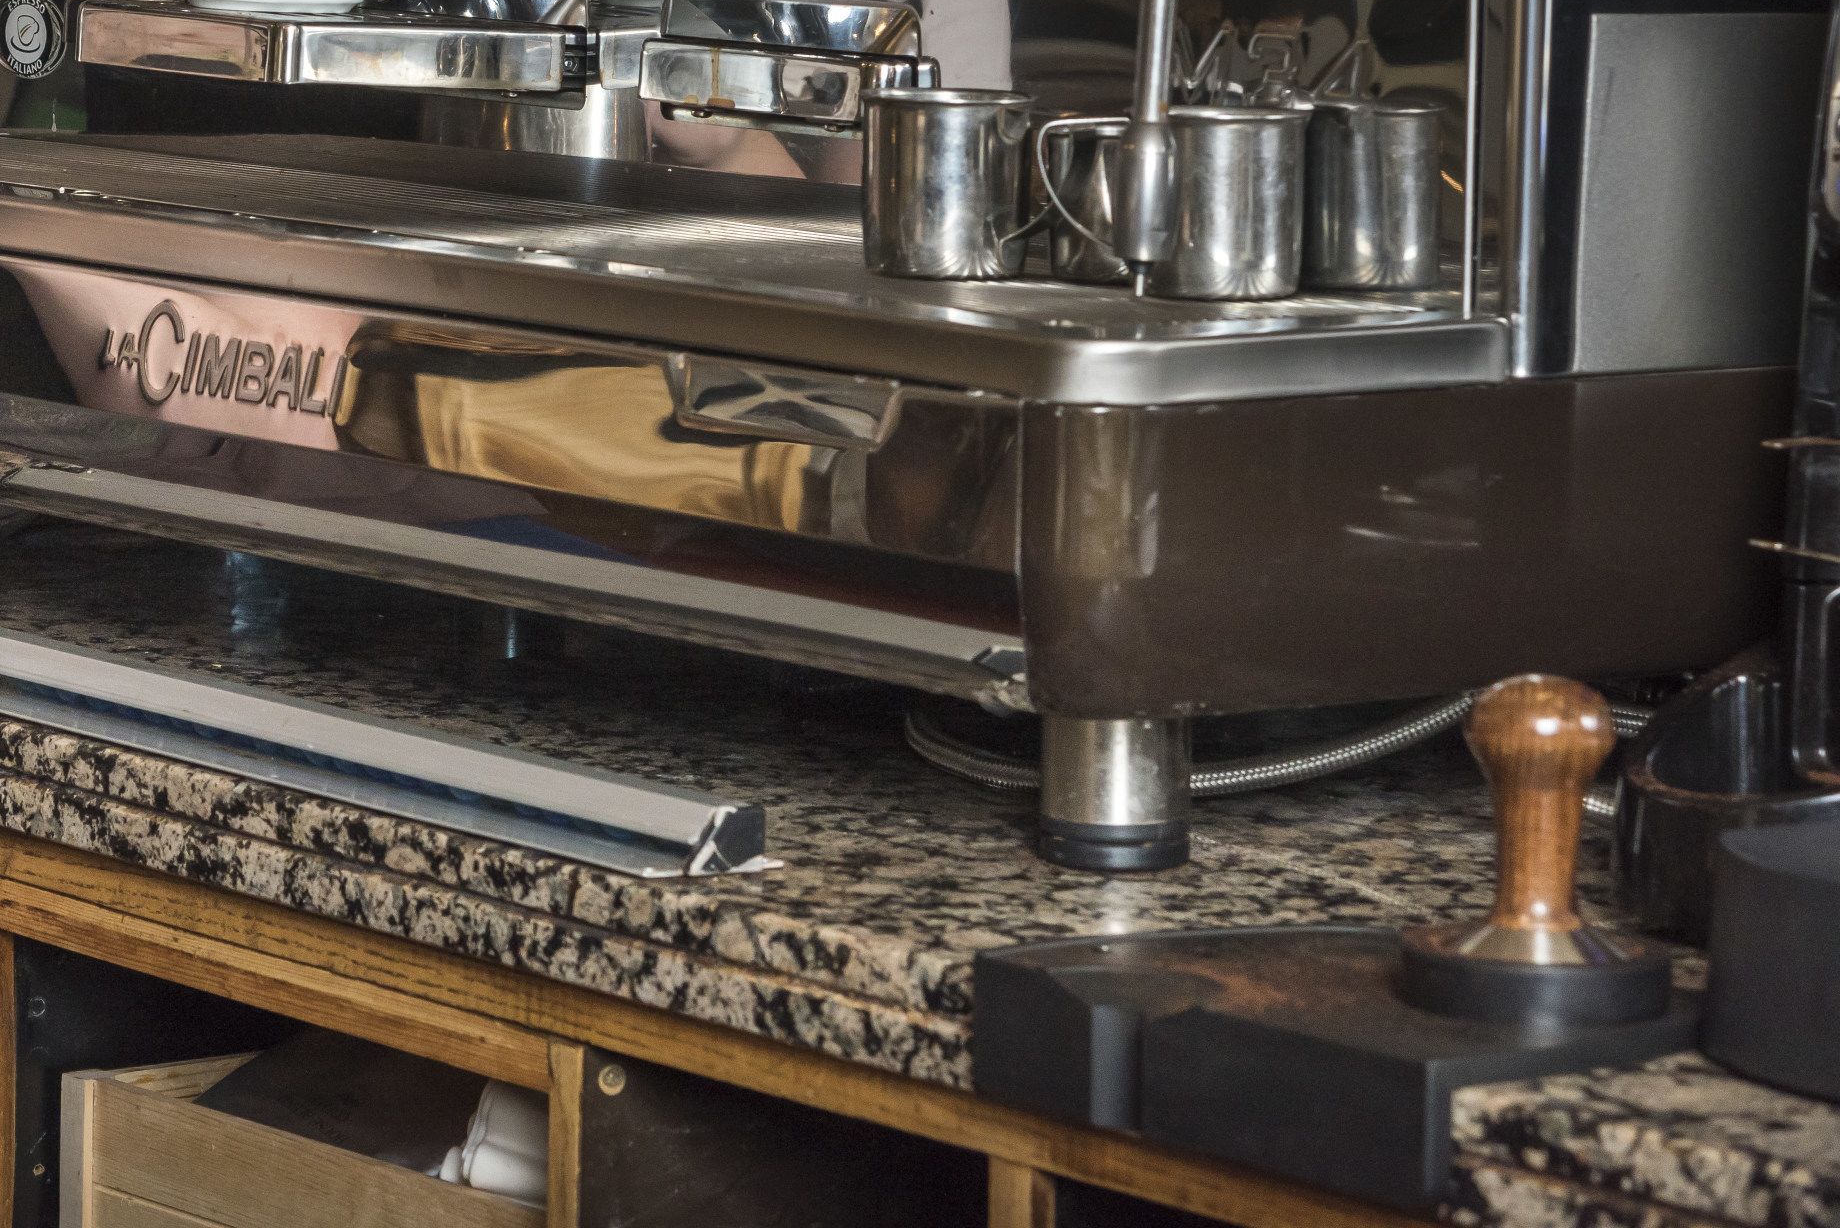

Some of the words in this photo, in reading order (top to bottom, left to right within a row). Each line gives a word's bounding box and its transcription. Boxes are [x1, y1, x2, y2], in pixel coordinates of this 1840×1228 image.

[7, 54, 43, 74] ITALIANO
[99, 328, 139, 370] LA
[137, 299, 348, 416] CIMBALI
